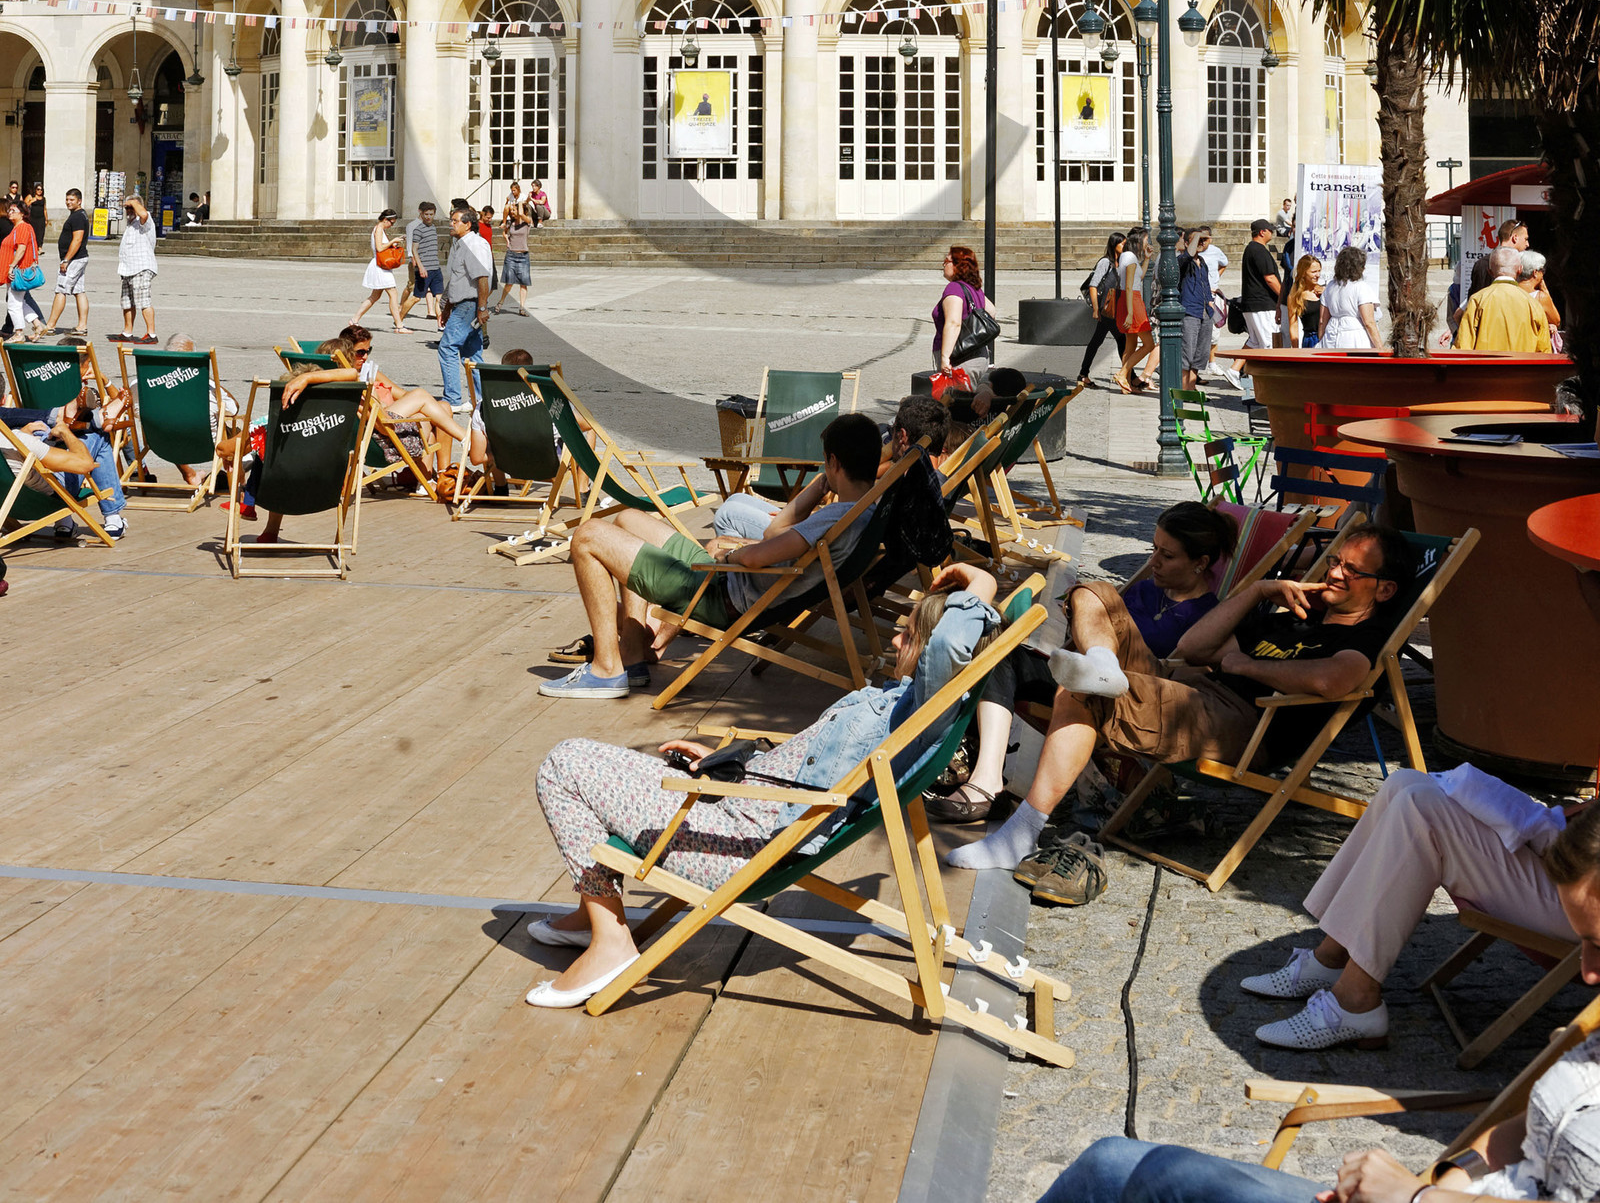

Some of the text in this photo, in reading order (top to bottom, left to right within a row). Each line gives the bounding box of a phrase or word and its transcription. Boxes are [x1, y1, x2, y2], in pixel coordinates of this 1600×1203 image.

[1310, 181, 1367, 193] transat
[24, 360, 57, 379] transat
[40, 361, 71, 381] en ville
[146, 367, 182, 388] transat
[165, 367, 199, 389] en ville
[491, 391, 525, 408] transat
[508, 402, 521, 412] en
[521, 393, 541, 408] ville
[280, 412, 327, 433] transat
[768, 394, 836, 431] www.rennes.fr
[302, 413, 345, 437] en ville
